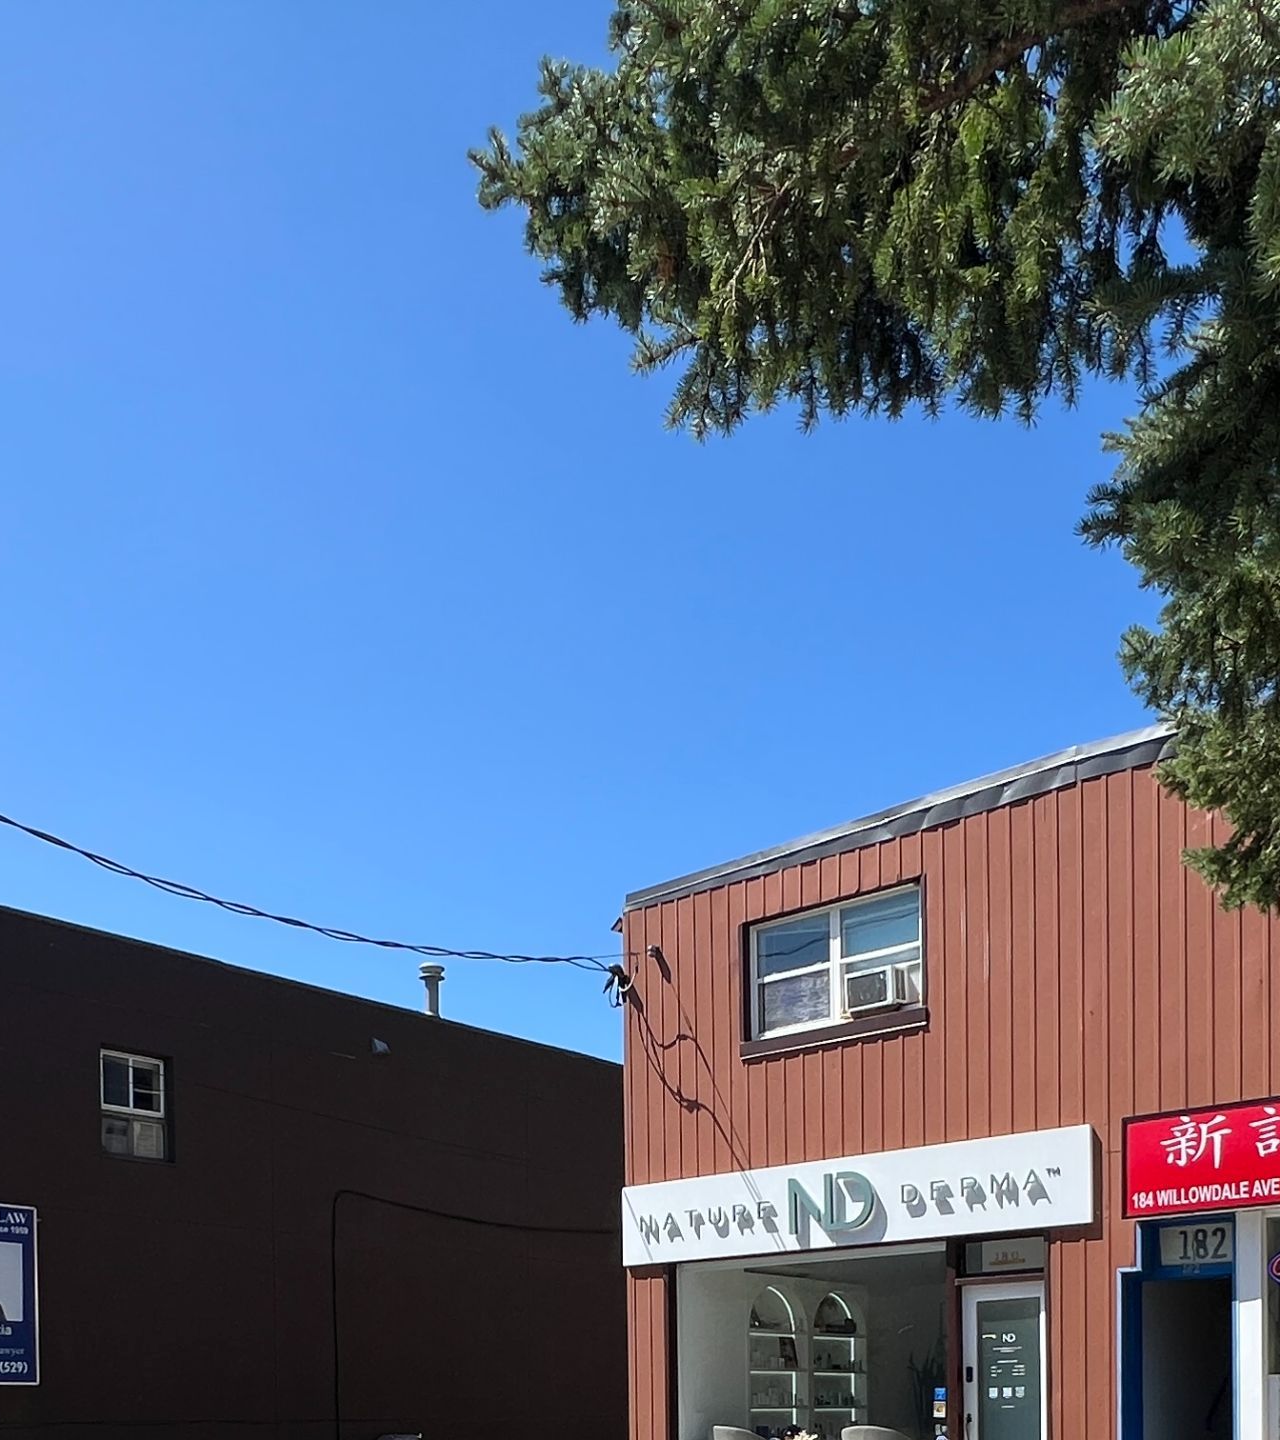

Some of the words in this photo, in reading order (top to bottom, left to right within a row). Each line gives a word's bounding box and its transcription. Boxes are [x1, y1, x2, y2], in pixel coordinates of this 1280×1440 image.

[639, 1200, 775, 1236] NATURE
[787, 1170, 877, 1236] ND
[1131, 1190, 1154, 1209] 184
[1156, 1180, 1250, 1207] WILLOWDALE
[1178, 1226, 1228, 1261] 182
[0, 1361, 29, 1374] (529)
